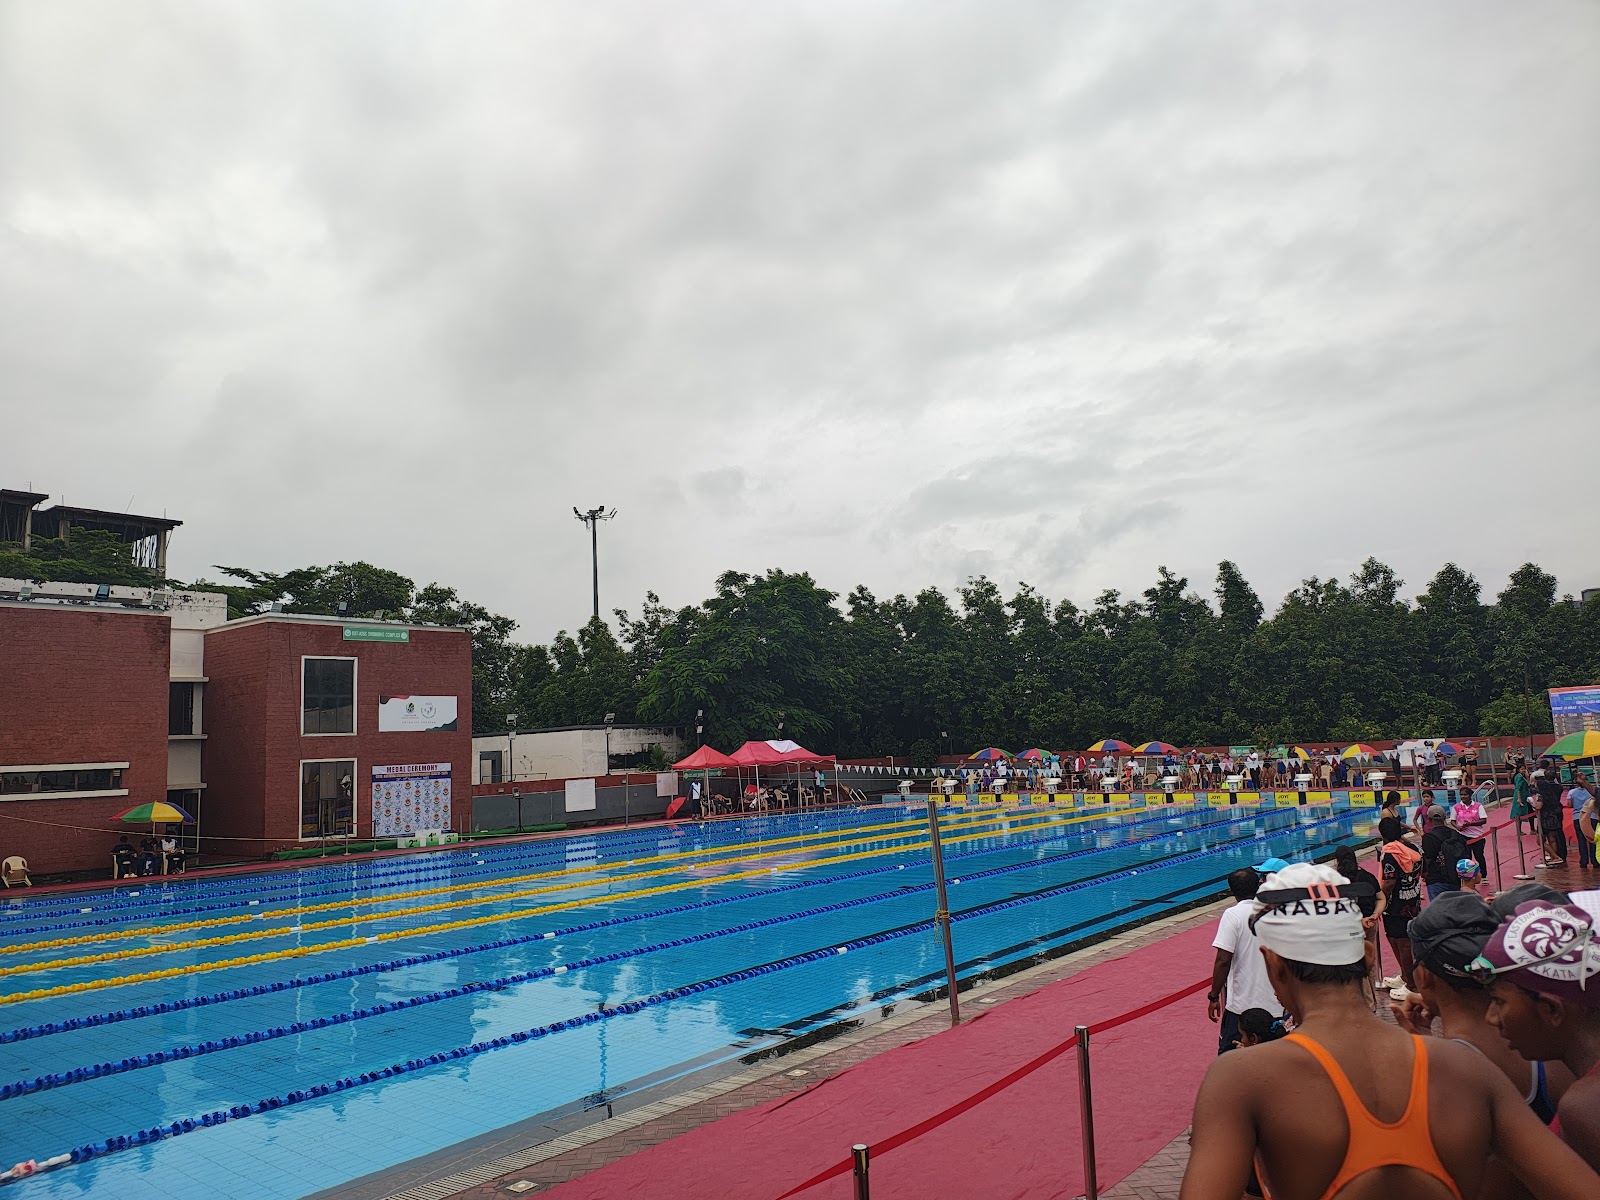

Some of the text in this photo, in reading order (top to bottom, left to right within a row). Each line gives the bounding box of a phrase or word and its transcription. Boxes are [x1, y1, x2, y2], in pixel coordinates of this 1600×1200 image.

[408, 764, 438, 772] CEREMONY
[1507, 911, 1535, 939] EASTERN
[1517, 954, 1577, 978] KLKATA
